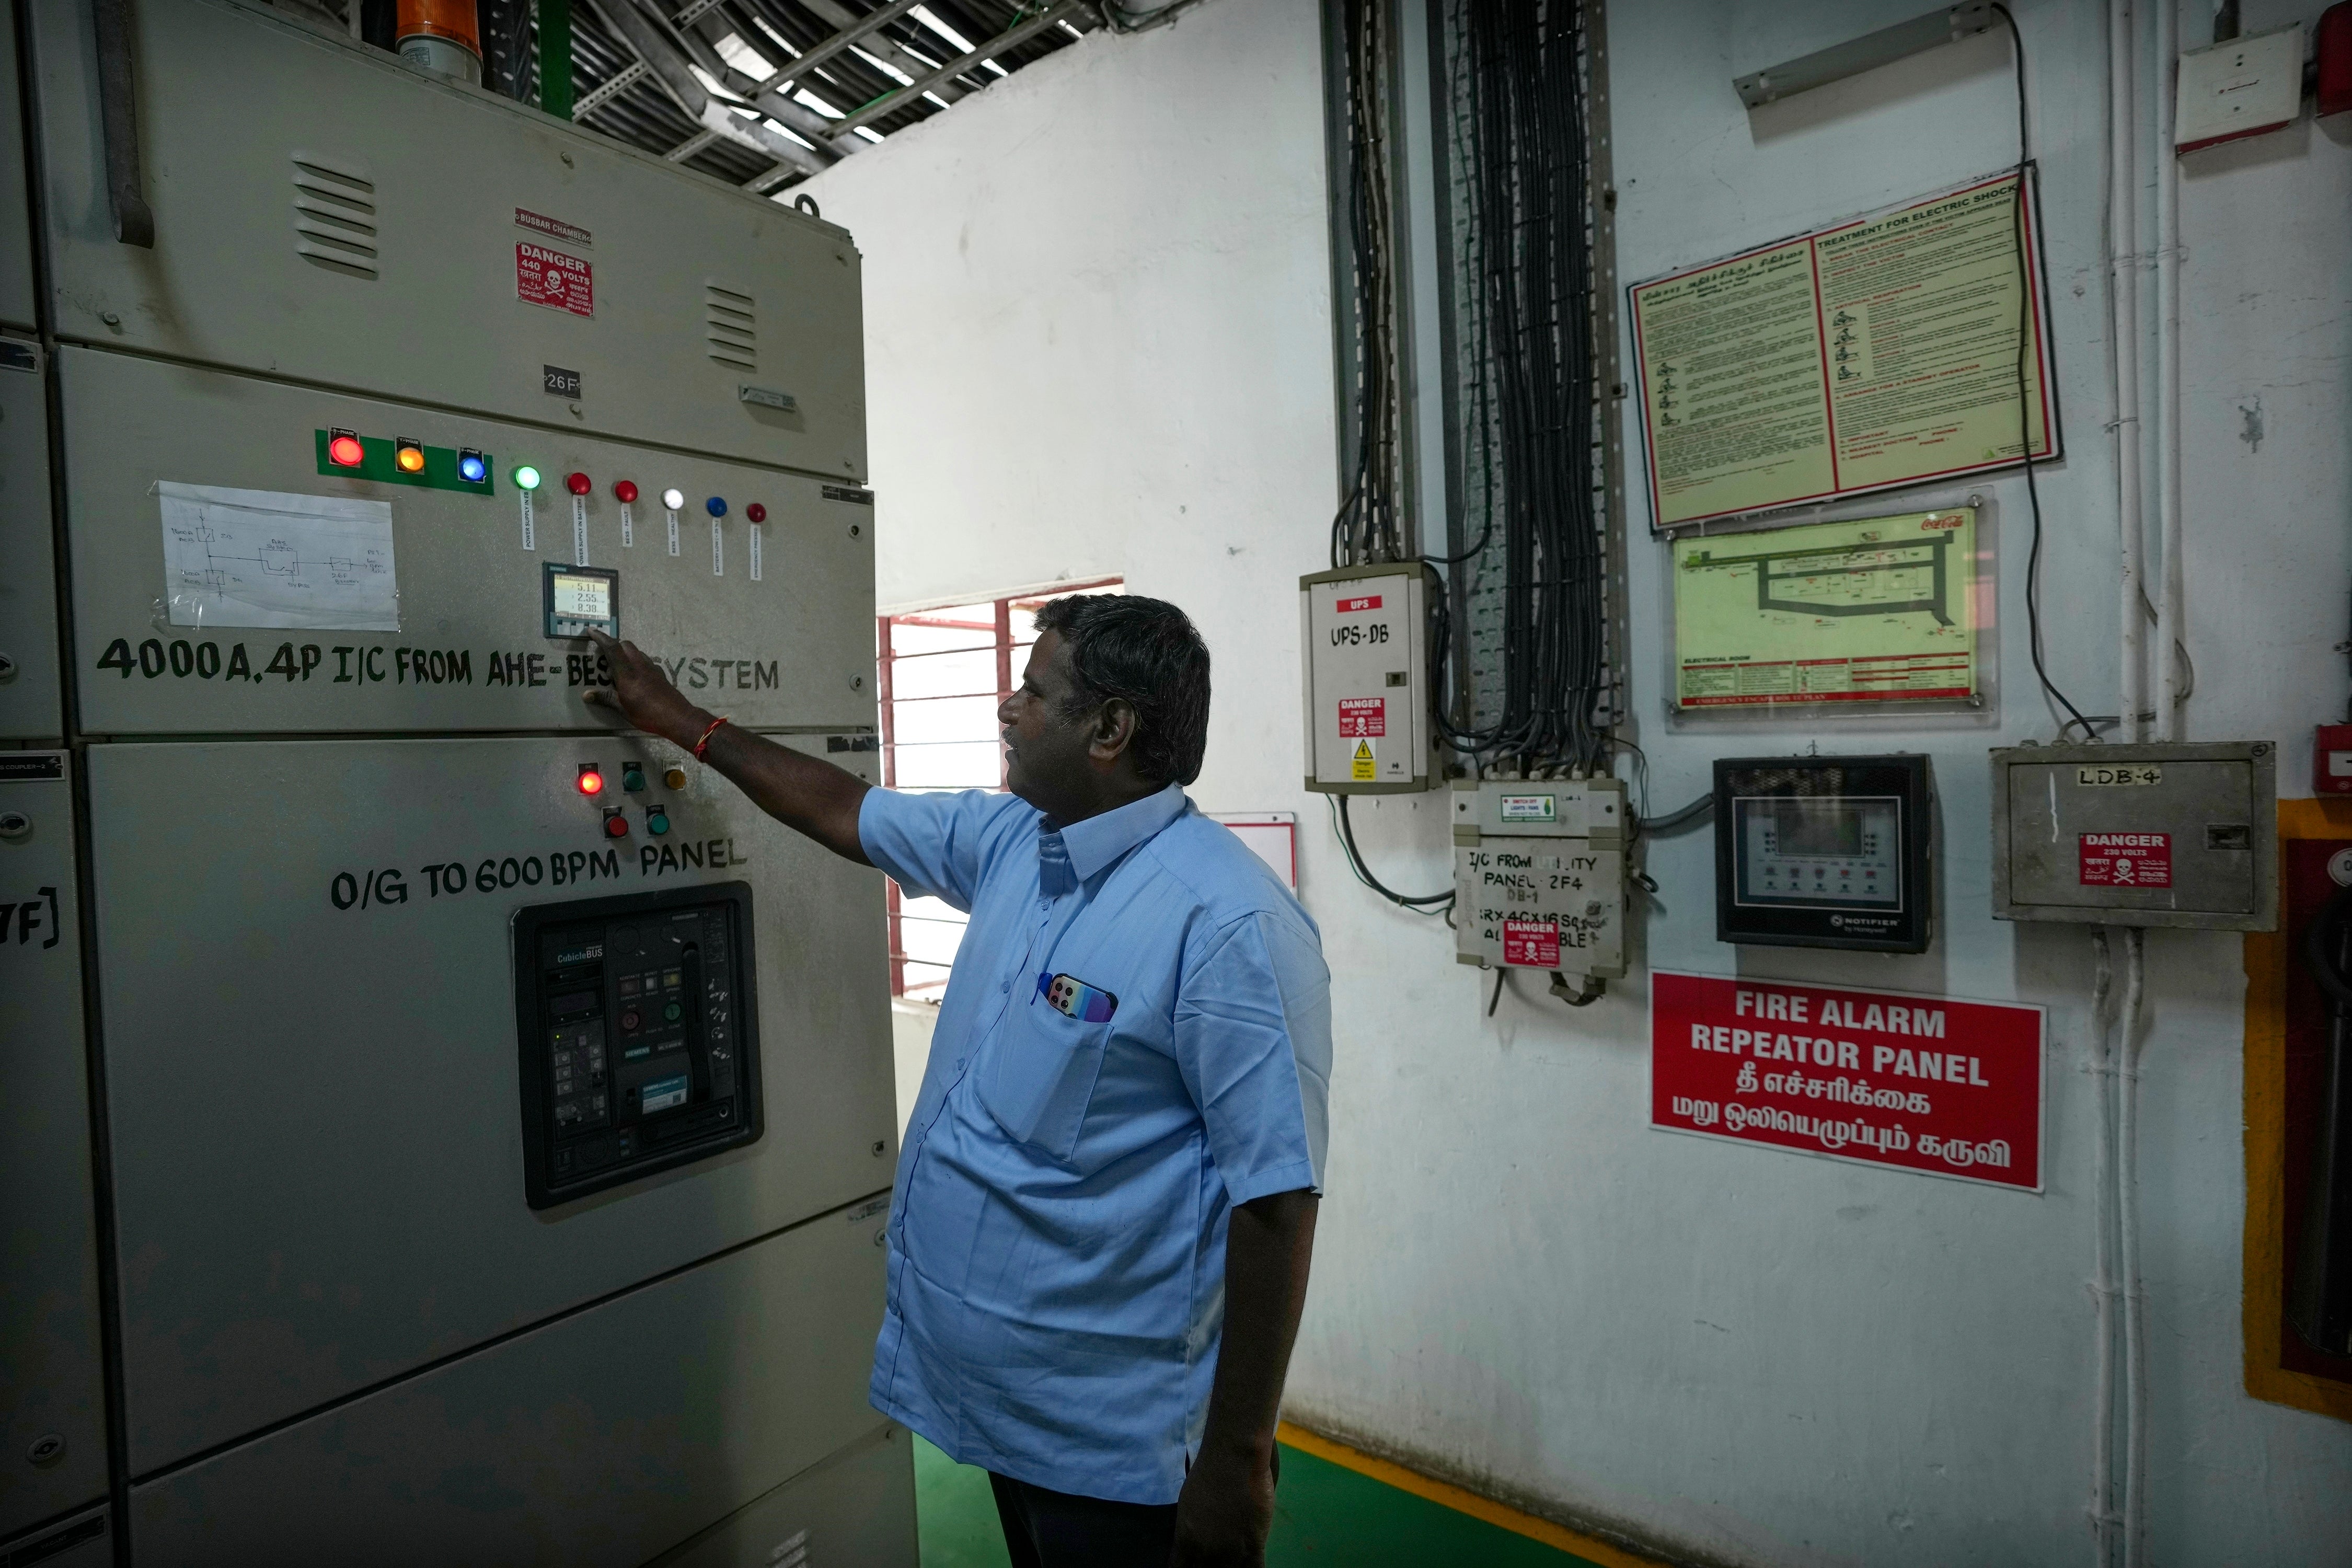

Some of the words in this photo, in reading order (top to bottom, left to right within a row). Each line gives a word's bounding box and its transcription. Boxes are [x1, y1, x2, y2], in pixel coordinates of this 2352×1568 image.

[1817, 224, 1883, 248] TREATMENT
[1886, 216, 1909, 229] FOR
[1912, 199, 1970, 221] ELECTRIC
[1973, 183, 2017, 203] SHOCK
[521, 213, 550, 230] BUSBAR
[552, 224, 587, 241] CHAMBER
[522, 244, 586, 273] DANGER
[522, 259, 540, 271] 440
[562, 270, 590, 285] VOLTS
[547, 373, 578, 391] 26F
[578, 583, 595, 592] 5.11
[578, 593, 596, 603] 2.55
[1351, 599, 1369, 609] UPS
[578, 603, 596, 613] 8.38
[1331, 624, 1389, 646] UPS-DB
[331, 646, 386, 685] I/C
[395, 647, 472, 686] FROM
[1341, 699, 1381, 709] DANGER
[2085, 834, 2165, 847] DANGER
[1497, 854, 1532, 869] FROM
[330, 869, 408, 910] O/G
[420, 861, 467, 897] TO
[475, 856, 543, 893] 600
[551, 849, 619, 885] BPM
[641, 837, 748, 876] PANEL
[1484, 872, 1536, 889] PANEL
[1549, 875, 1583, 890] 2F4
[1507, 922, 1554, 933] DANGER
[1844, 918, 1898, 926] NOTIFIER
[557, 948, 603, 963] CubicleBUS
[1735, 990, 1809, 1024] FIRE
[1819, 999, 1945, 1039] ALARM
[625, 1046, 651, 1059] SIEMENS
[1691, 1023, 1860, 1070] REPEATOR
[1872, 1045, 1989, 1087] PANEL
[1735, 1061, 1759, 1095] தீ
[1763, 1070, 1932, 1115] எச்சரிக்கை
[1672, 1095, 1720, 1127] மறு
[1724, 1101, 1911, 1154] ஒலியெழுப்பும்
[1916, 1133, 2011, 1168] கருவி
